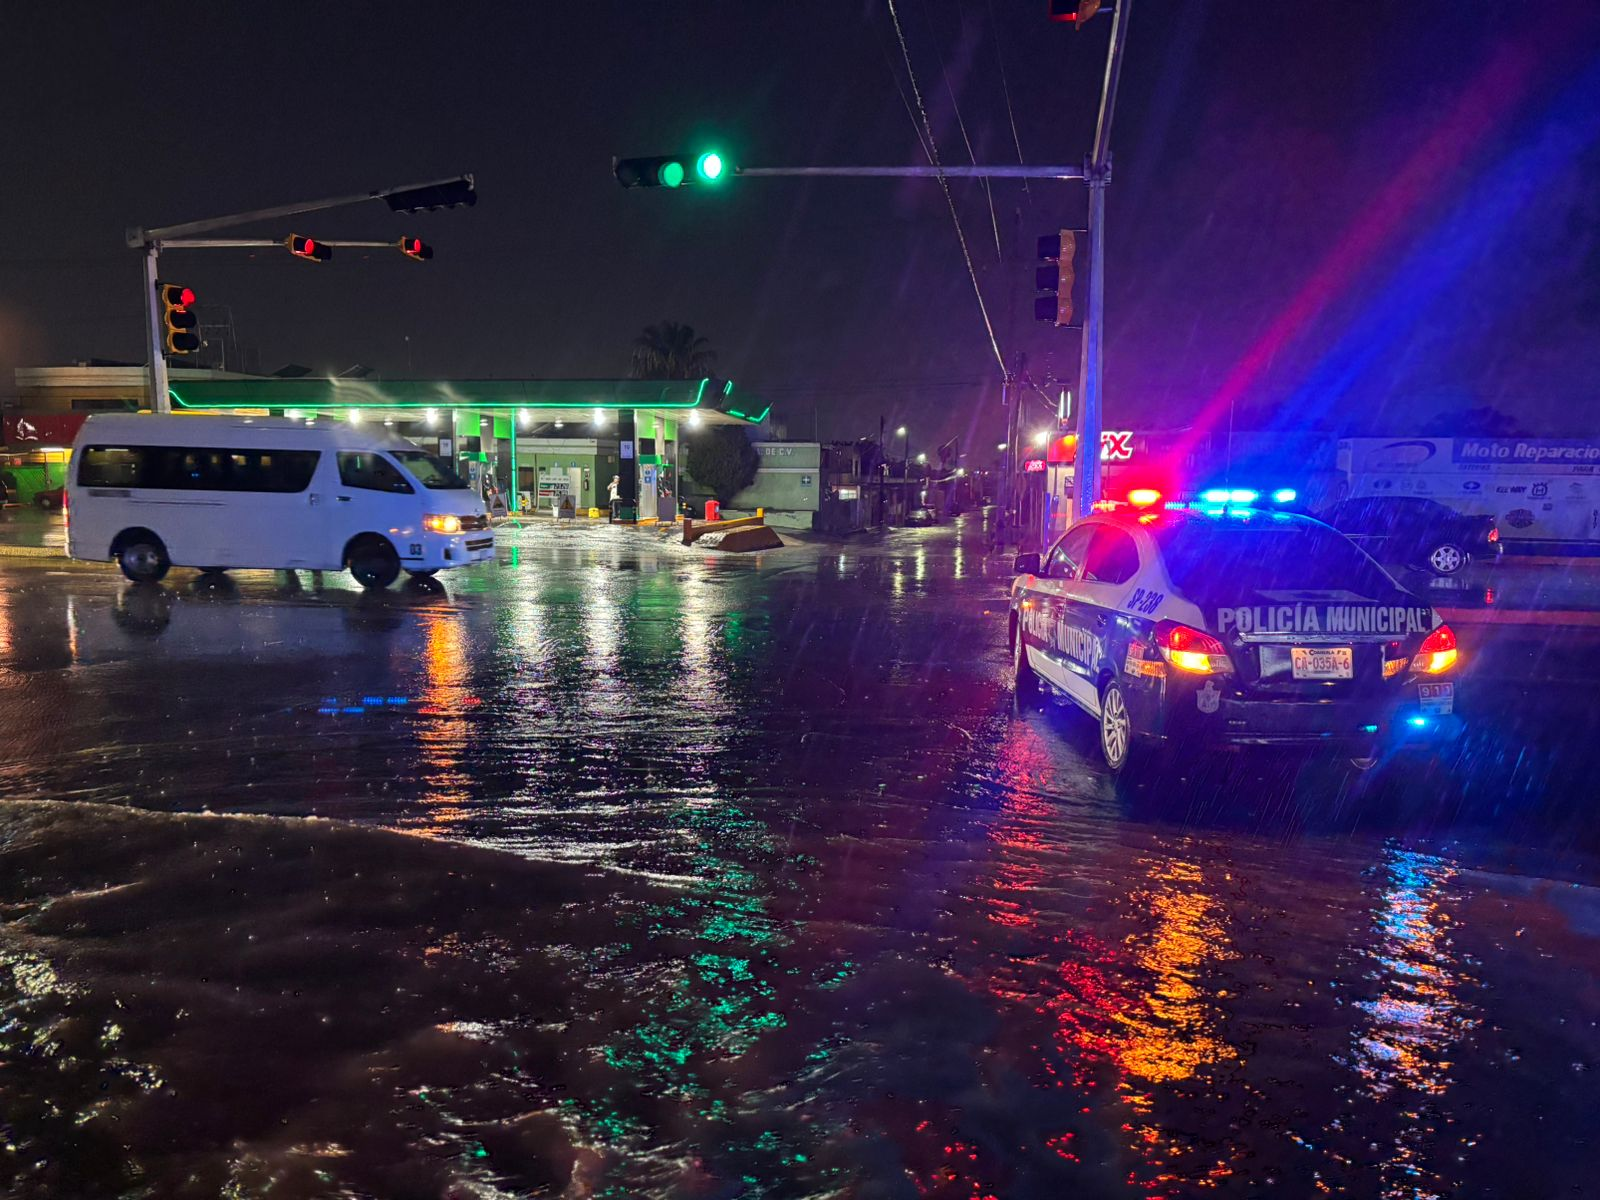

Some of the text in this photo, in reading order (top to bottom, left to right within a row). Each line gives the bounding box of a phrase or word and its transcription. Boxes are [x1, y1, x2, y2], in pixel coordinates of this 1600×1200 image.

[1461, 442, 1509, 458] Moto
[1217, 602, 1426, 633] POLICÍA MUNICIPAL
[1294, 656, 1350, 671] CA-035A-6
